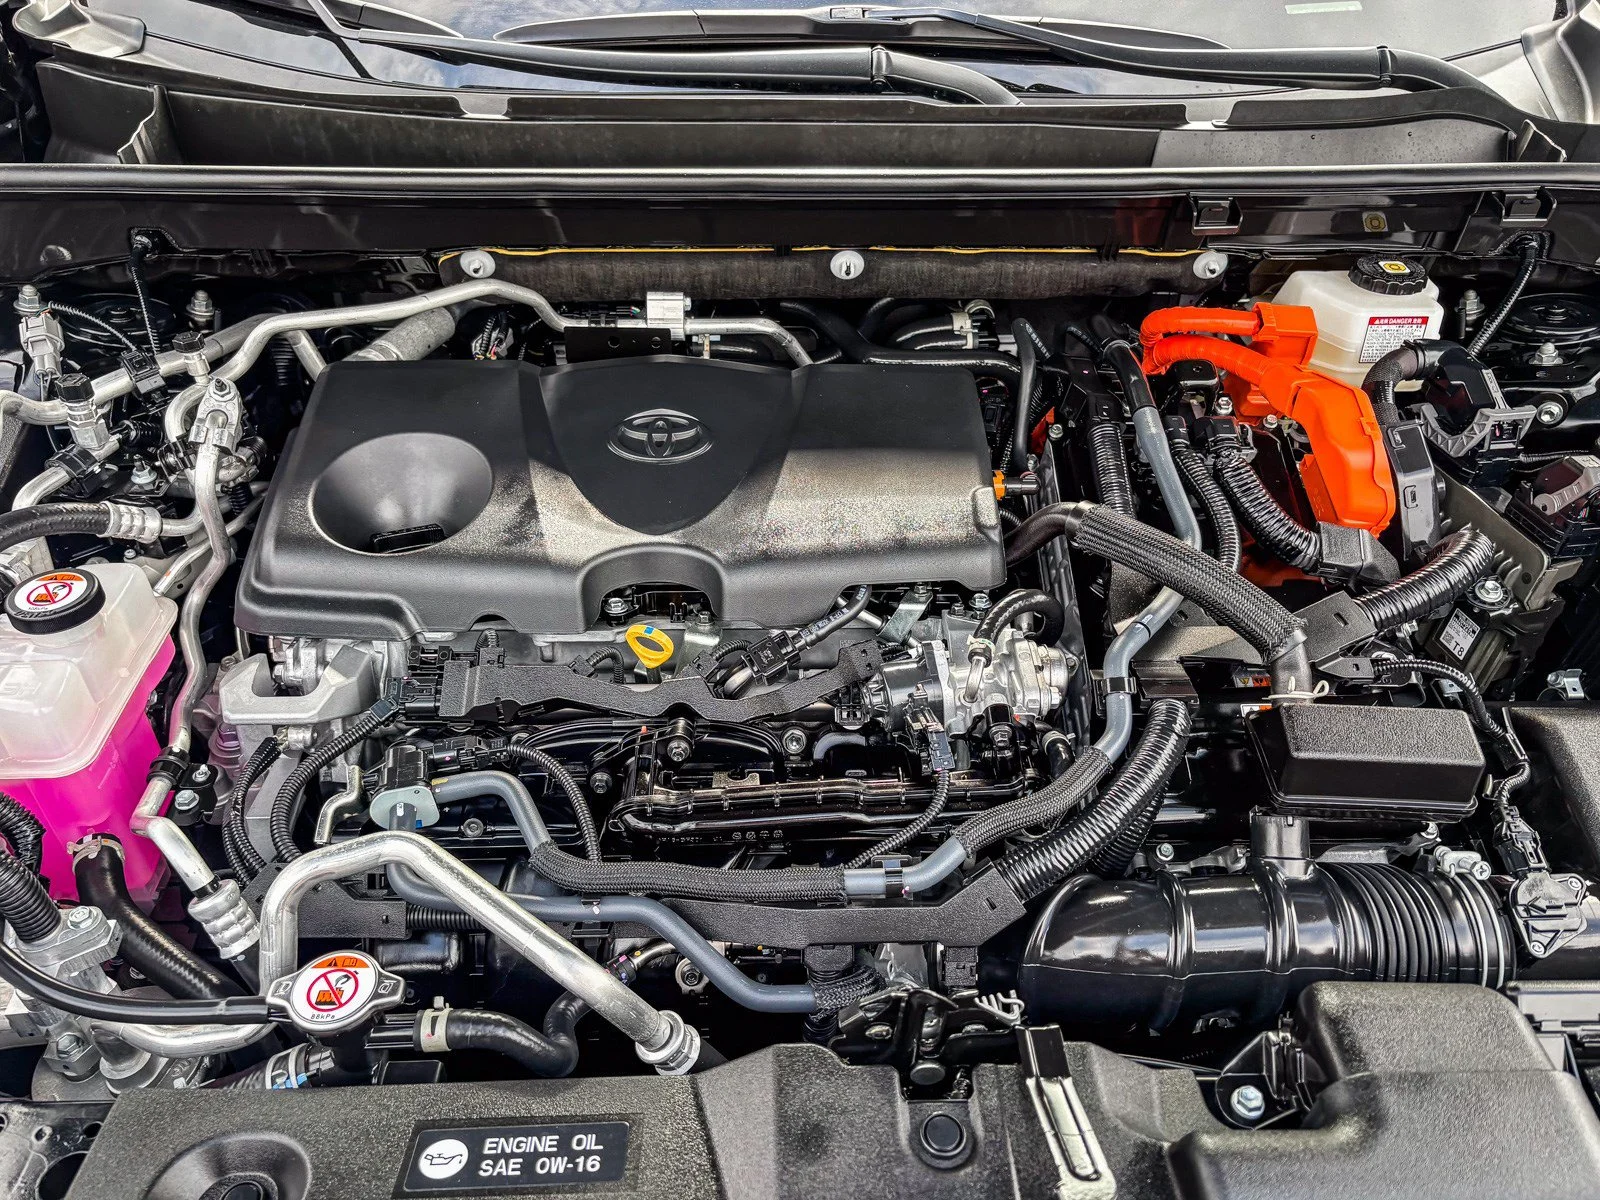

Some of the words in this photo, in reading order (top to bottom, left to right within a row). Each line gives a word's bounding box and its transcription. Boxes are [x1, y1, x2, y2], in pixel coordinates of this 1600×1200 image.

[1453, 640, 1465, 657] T8
[483, 1135, 559, 1154] ENGINE
[571, 1133, 604, 1151] OIL
[478, 1158, 523, 1176] SAE
[535, 1155, 601, 1174] 0W-16
